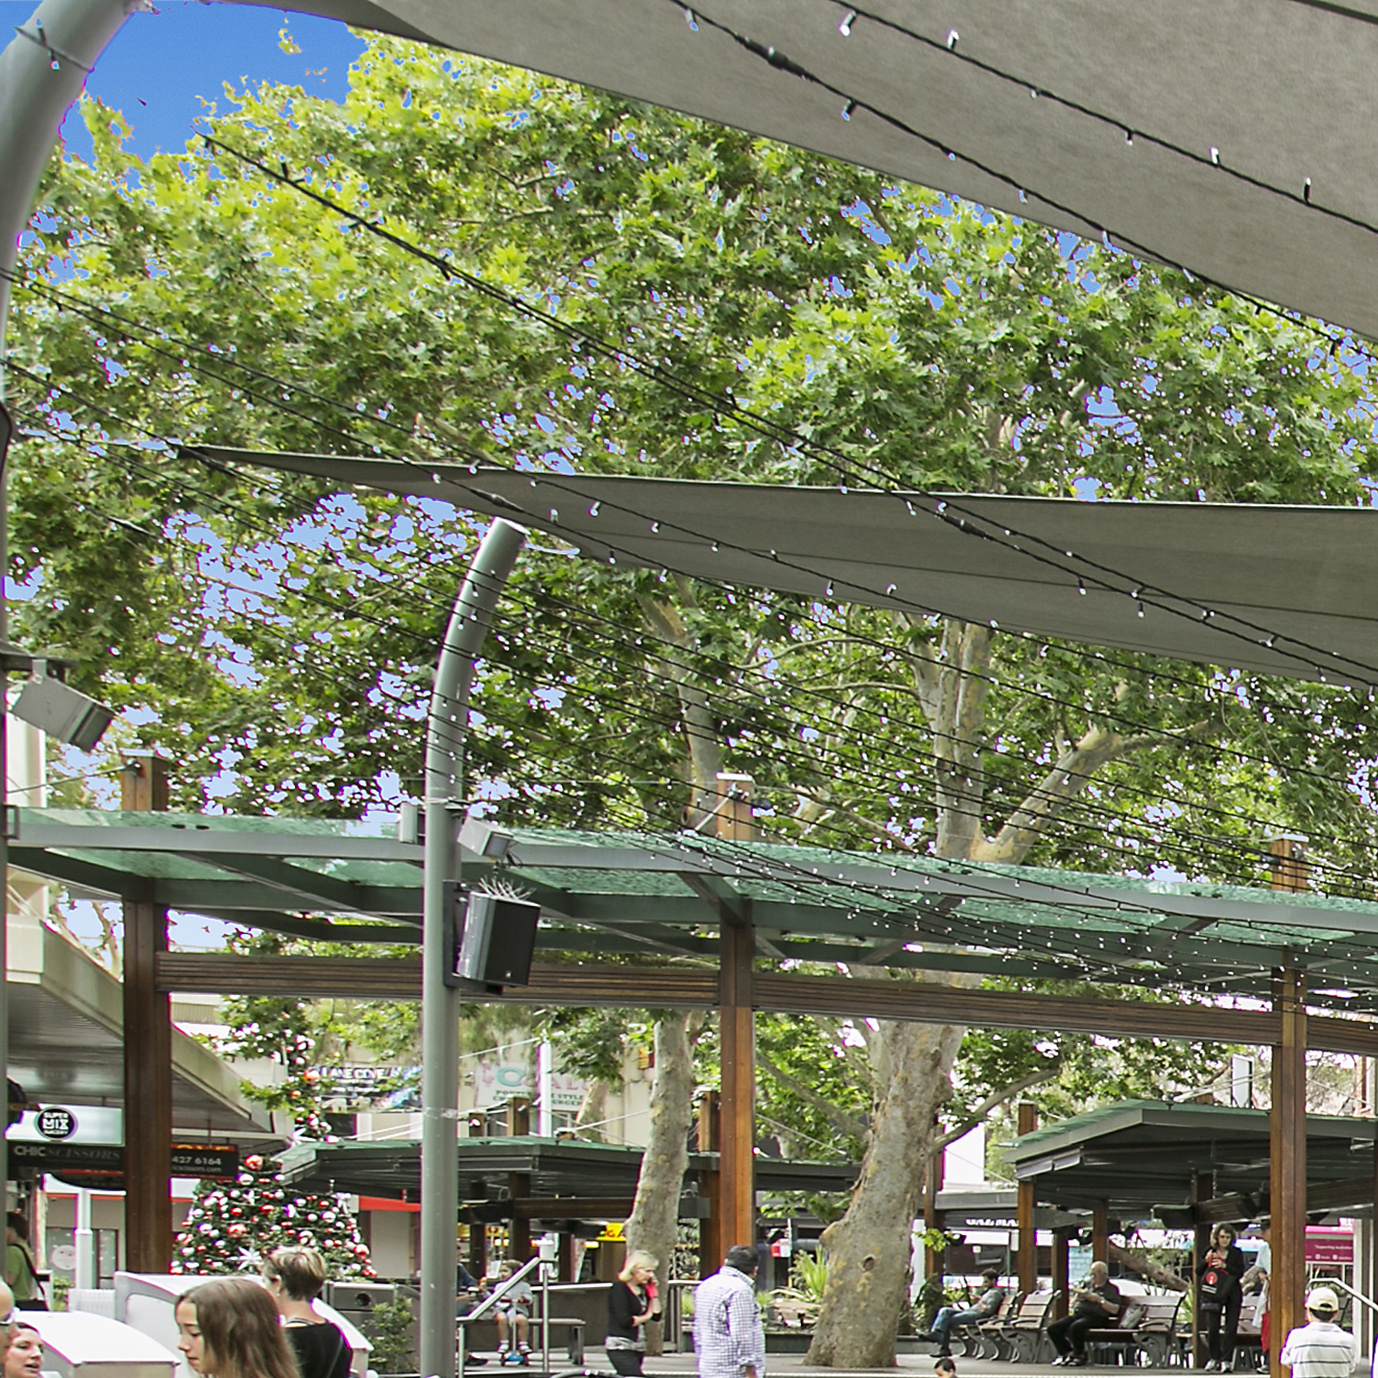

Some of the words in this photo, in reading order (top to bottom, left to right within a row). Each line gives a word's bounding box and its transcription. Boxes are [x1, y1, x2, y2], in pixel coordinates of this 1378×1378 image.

[14, 1145, 46, 1157] CHIC
[47, 1147, 121, 1160] SCISSORS
[195, 1157, 222, 1165] 6164
